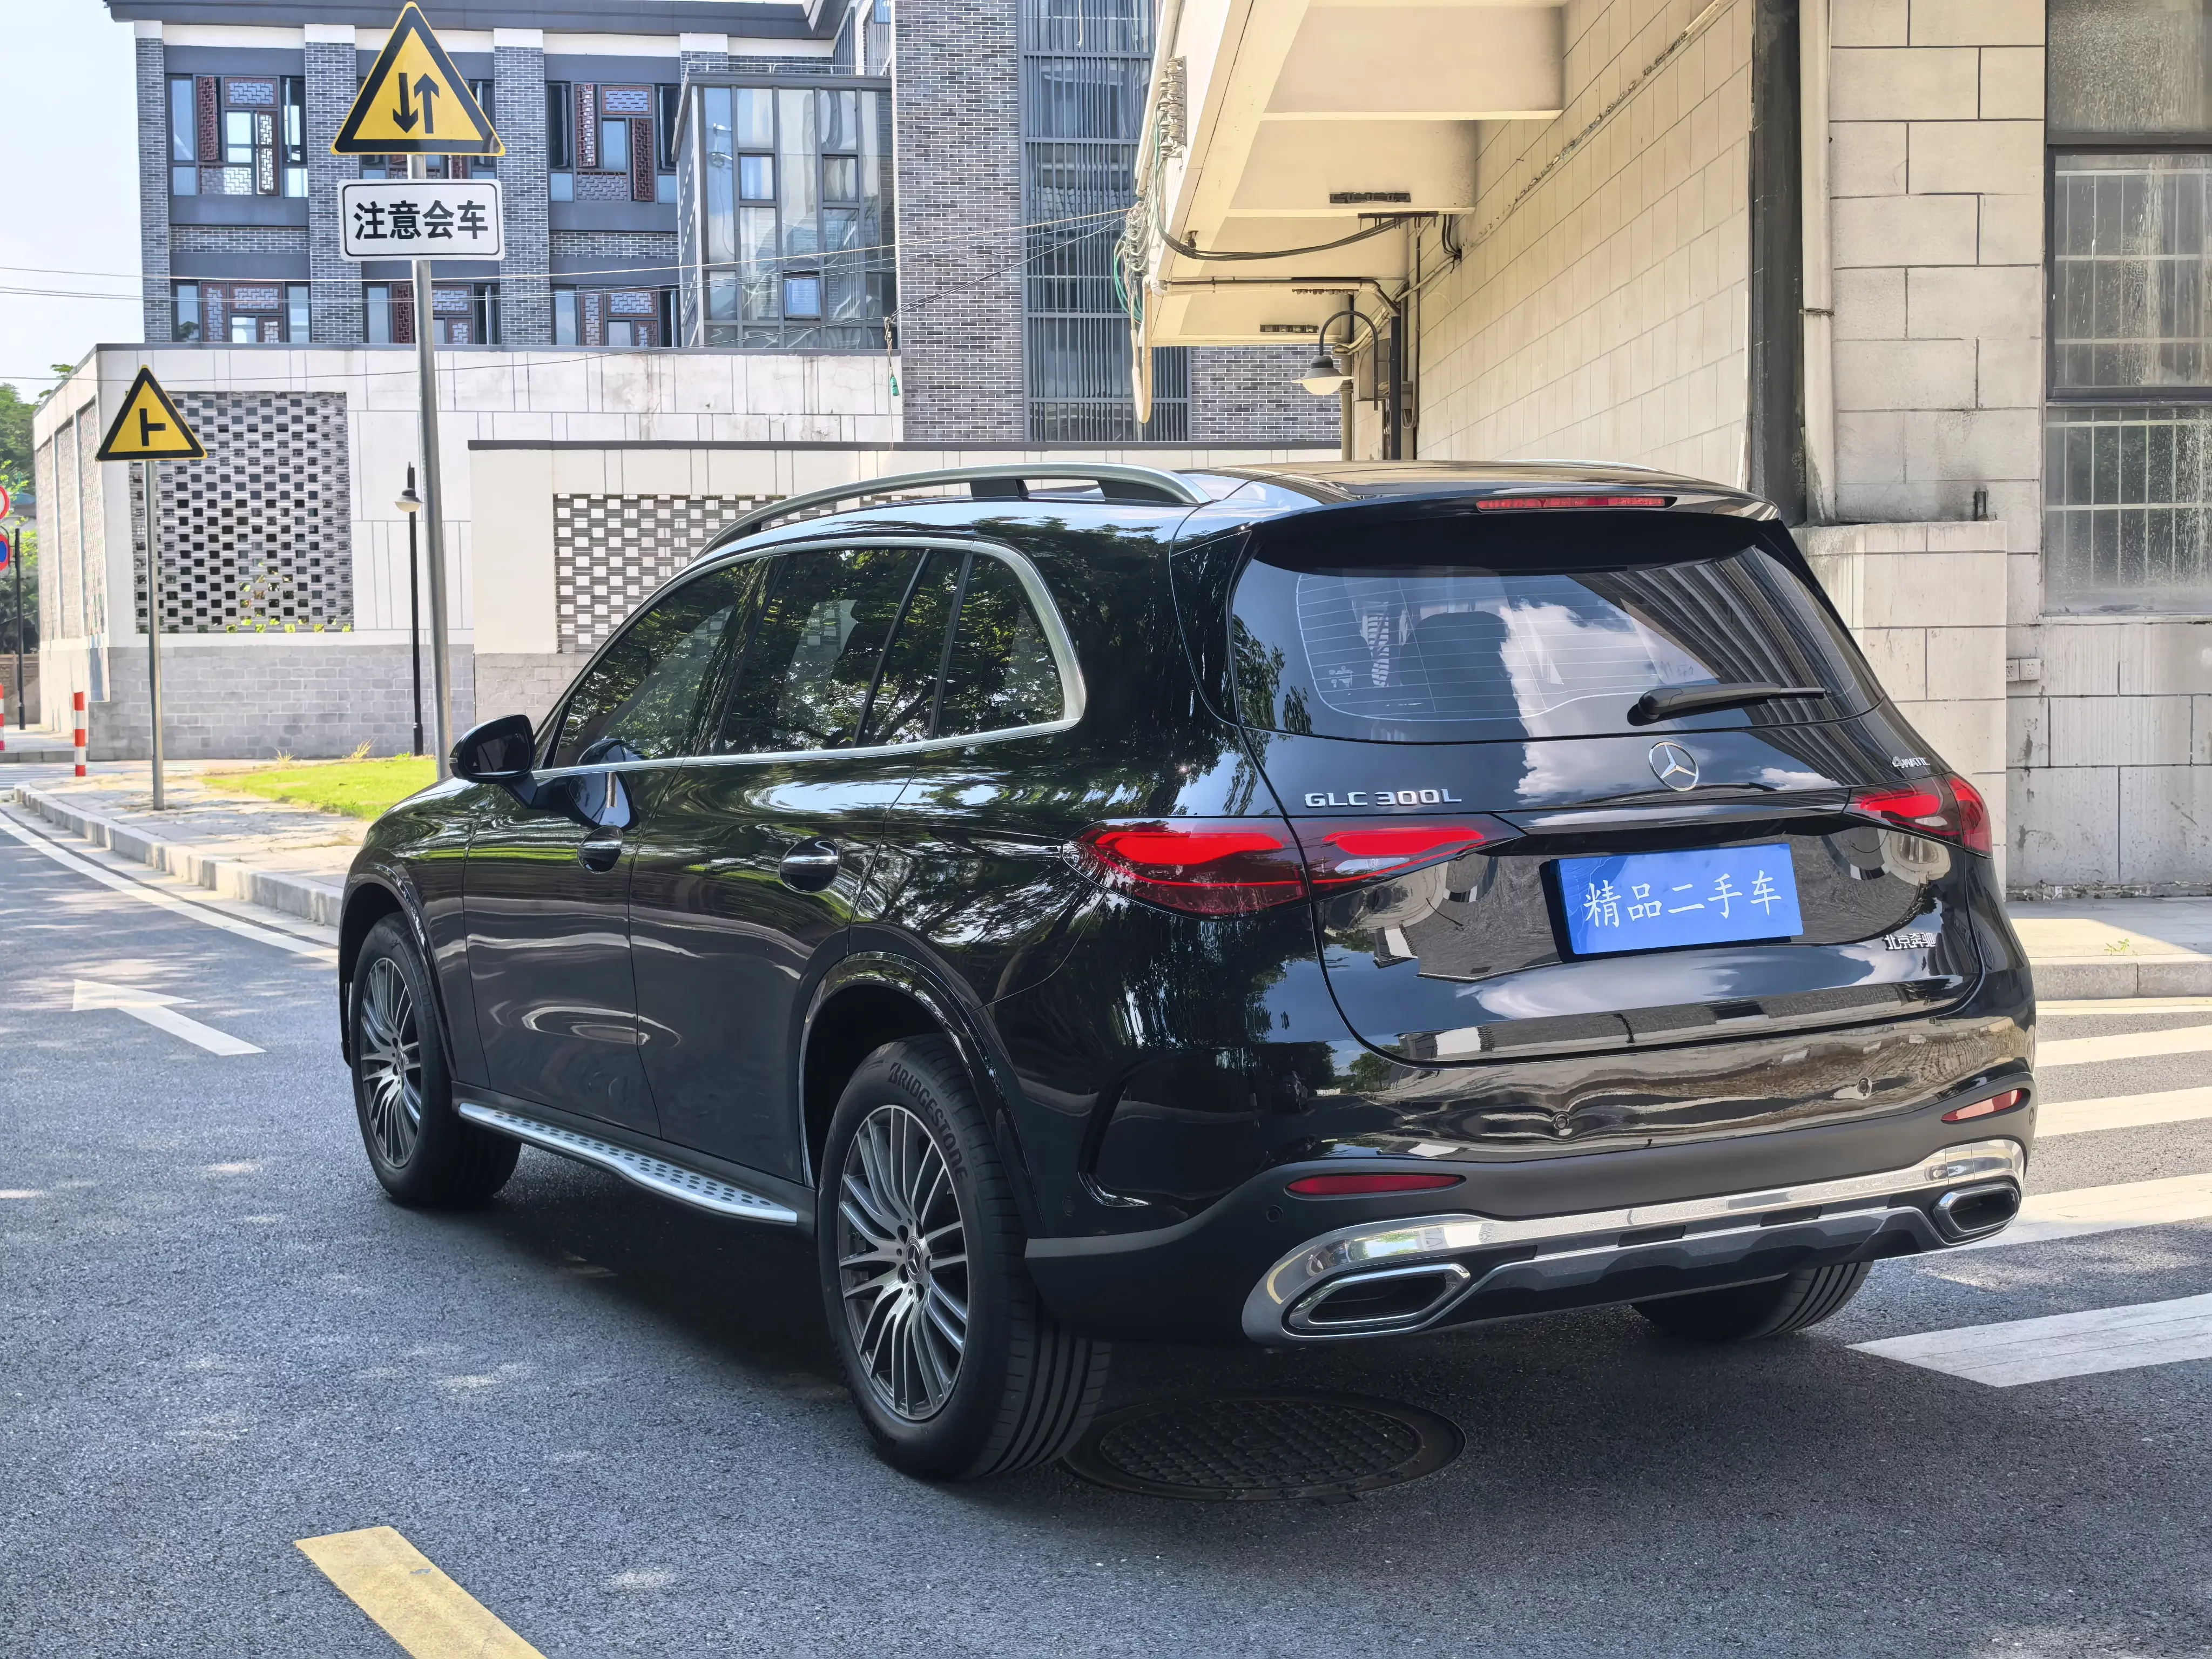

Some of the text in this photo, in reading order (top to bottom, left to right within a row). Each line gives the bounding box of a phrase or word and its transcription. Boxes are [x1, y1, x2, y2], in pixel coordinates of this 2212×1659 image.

[354, 200, 488, 239] 注意会车
[1305, 788, 1462, 807] GLC 300L
[1583, 869, 1782, 928] 精品二手车
[1884, 933, 1936, 949] 北京奔驰
[887, 1062, 968, 1183] BRIDGESTONE
